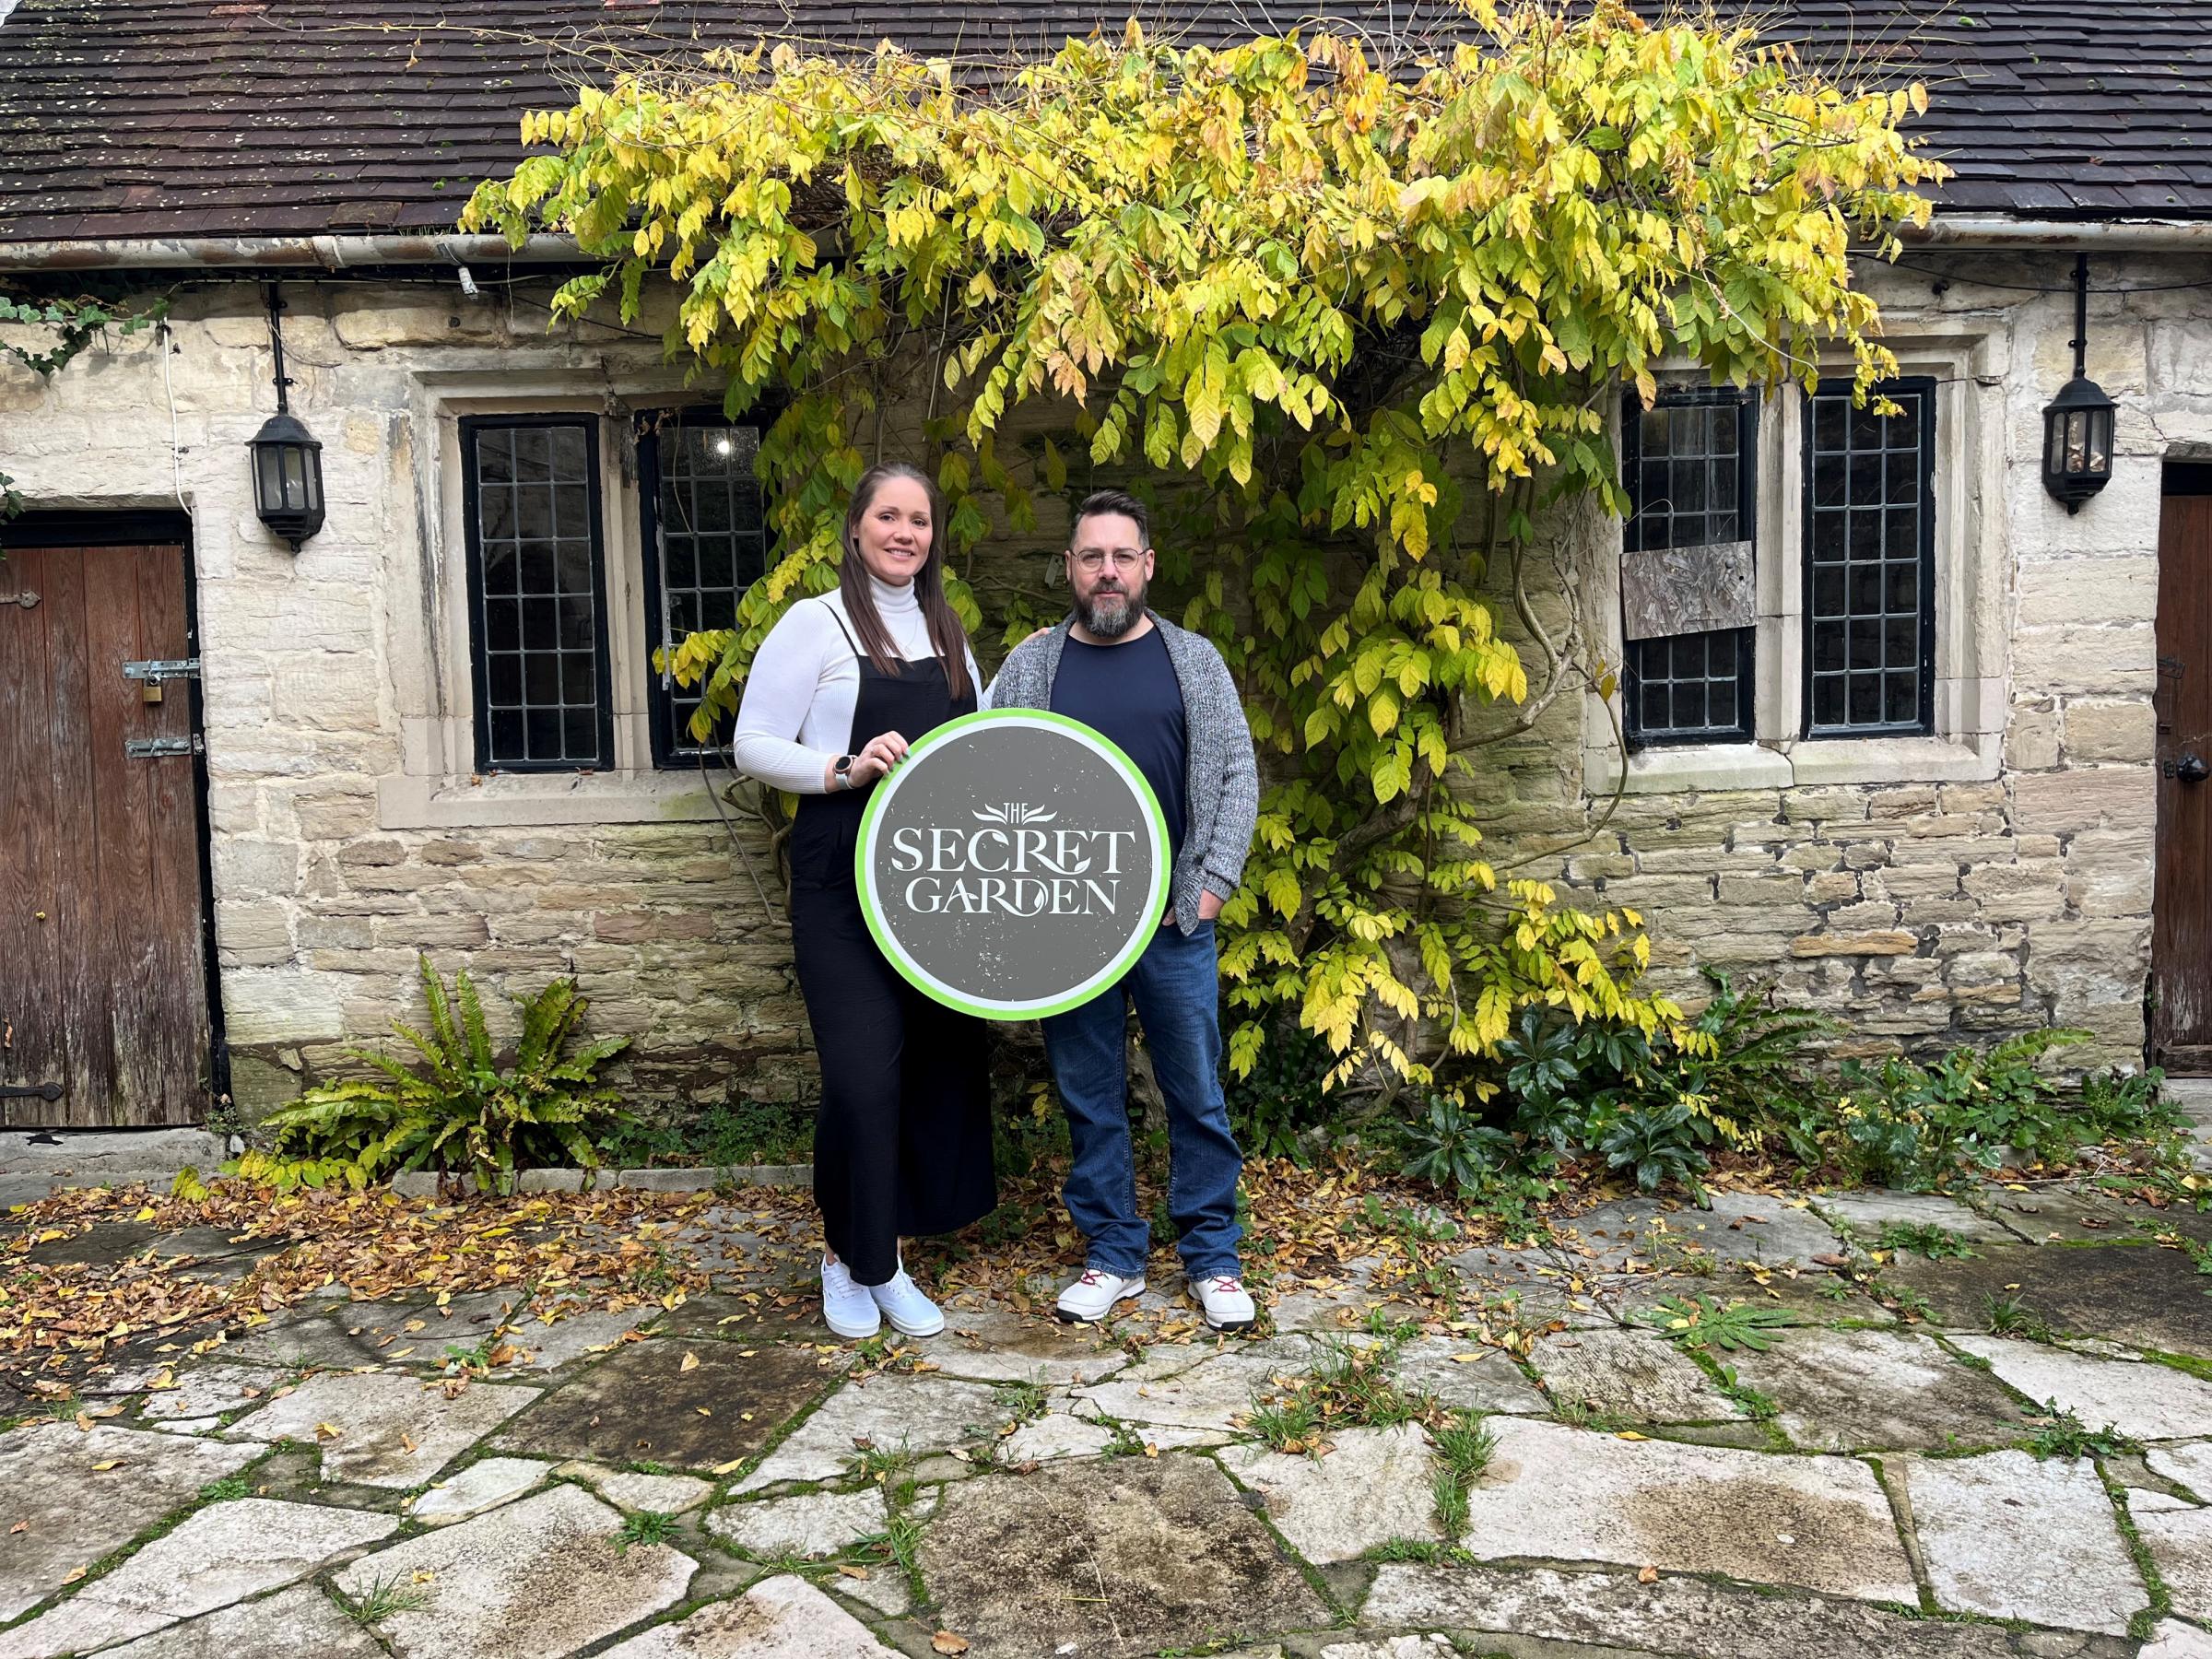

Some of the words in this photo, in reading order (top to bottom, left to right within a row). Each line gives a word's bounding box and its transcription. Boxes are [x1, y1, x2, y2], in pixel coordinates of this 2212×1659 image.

[1003, 802, 1029, 824] THE
[891, 828, 1135, 875] SECRET
[905, 877, 1121, 916] GARDEN
